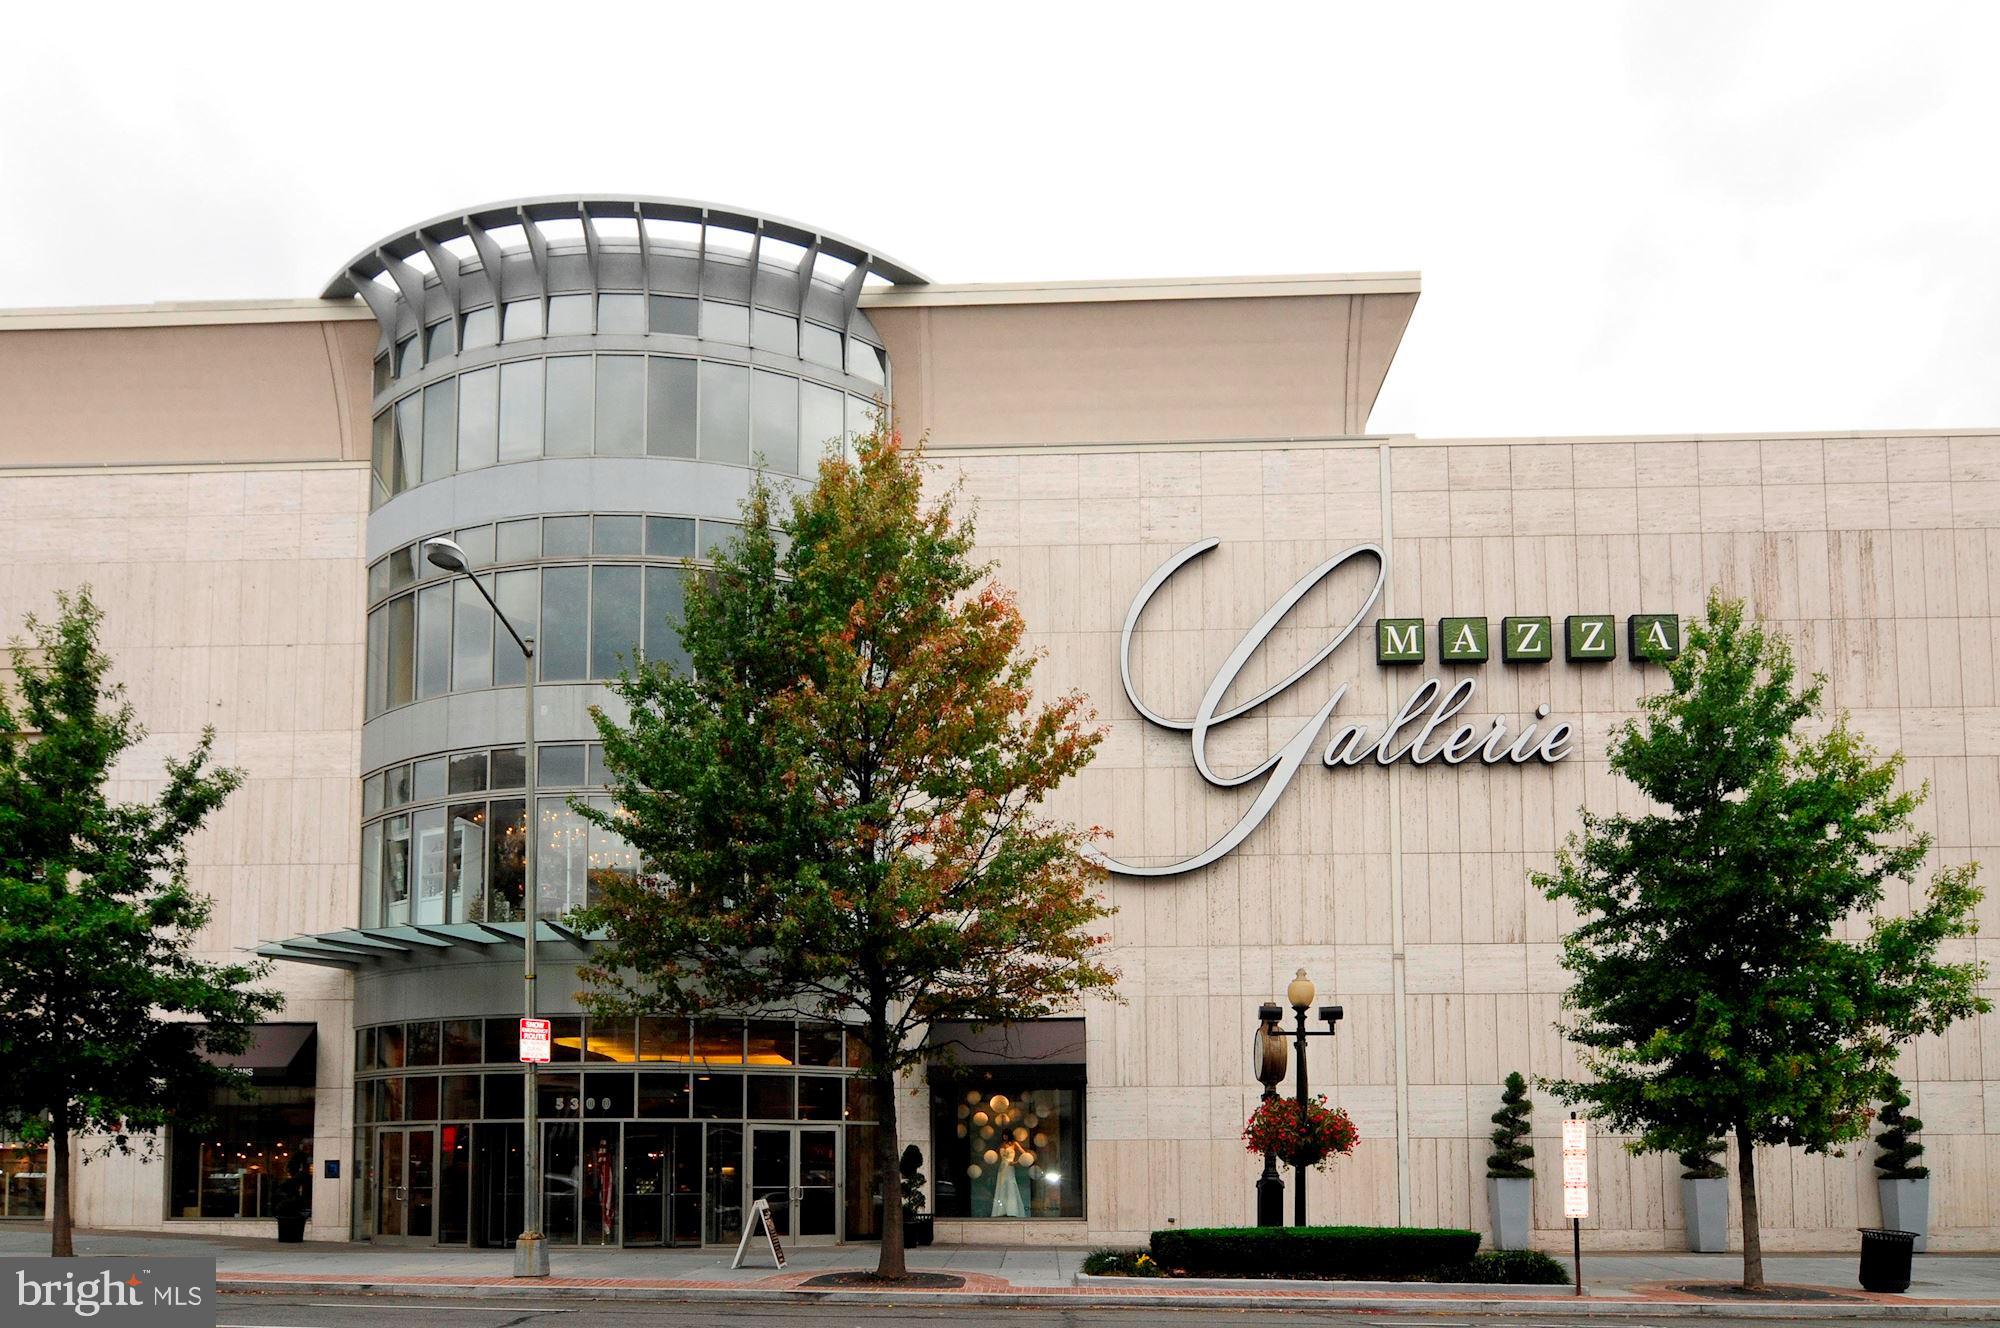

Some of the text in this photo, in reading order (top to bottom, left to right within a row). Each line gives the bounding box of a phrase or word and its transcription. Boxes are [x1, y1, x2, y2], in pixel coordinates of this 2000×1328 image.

[1384, 620, 1673, 655] MAZZA
[1080, 536, 1574, 877] Gallerie
[526, 1021, 545, 1029] SNOW
[523, 1032, 546, 1040] ROUTE
[555, 1097, 612, 1110] 5300
